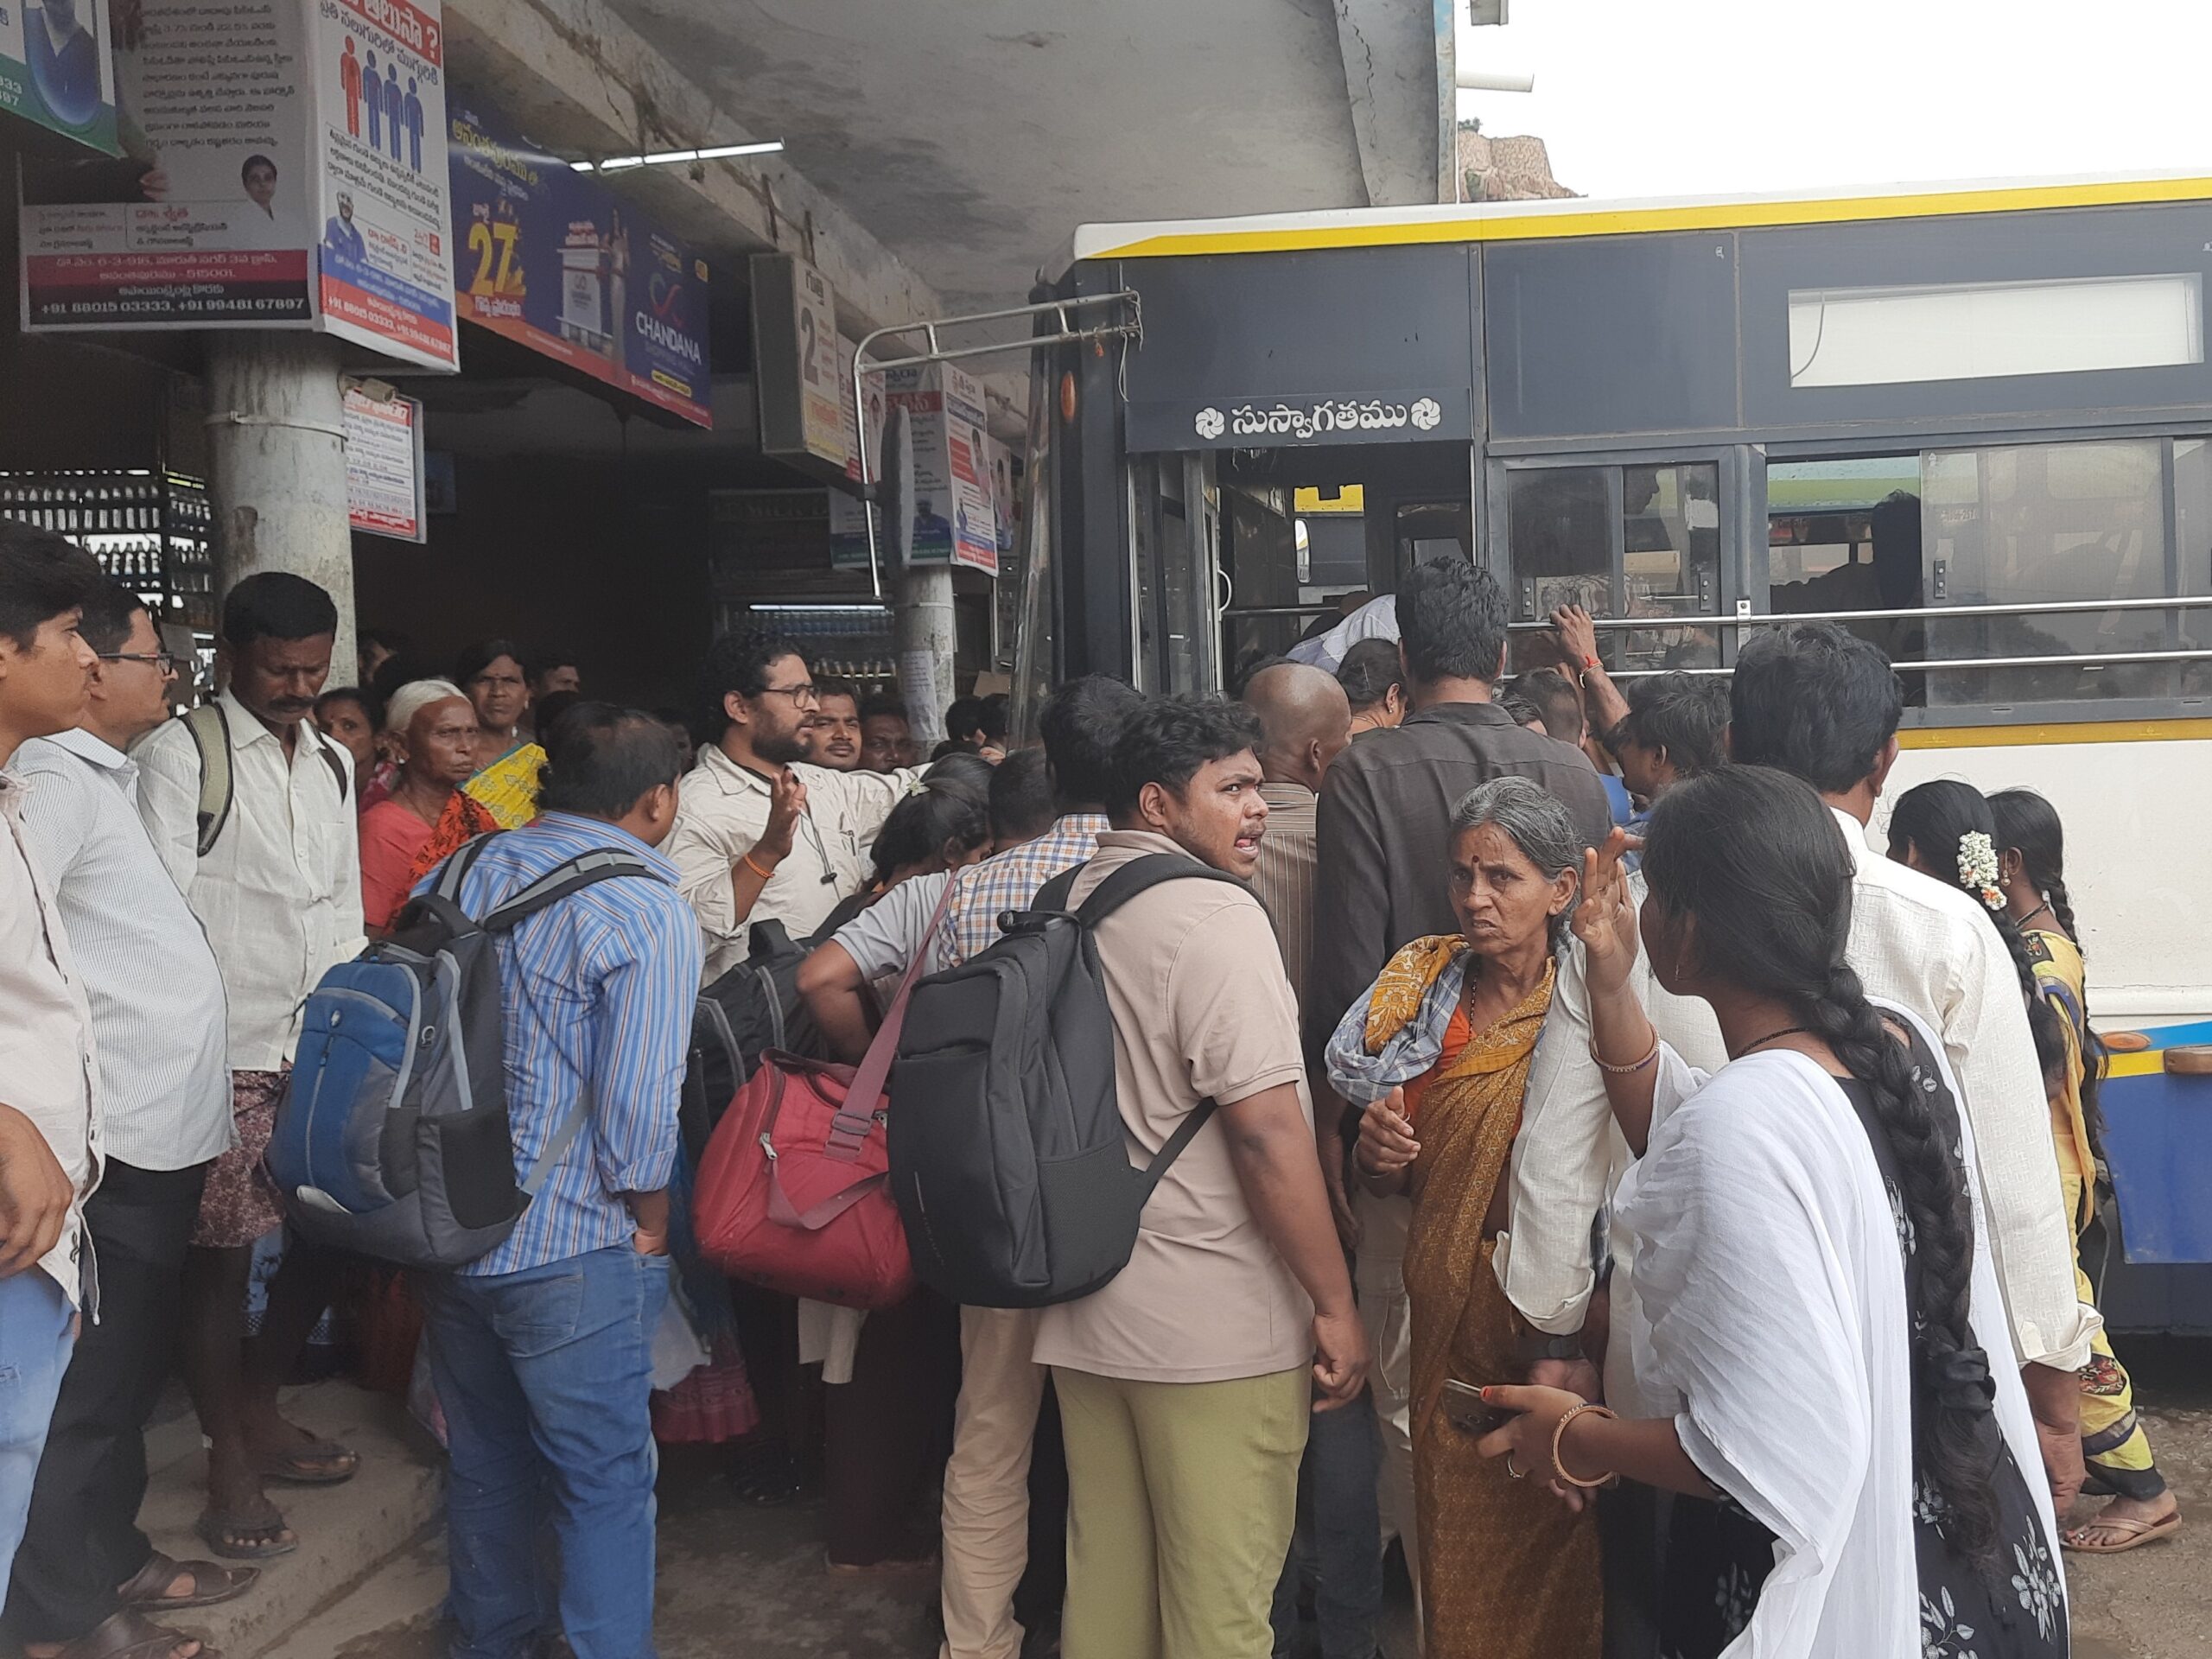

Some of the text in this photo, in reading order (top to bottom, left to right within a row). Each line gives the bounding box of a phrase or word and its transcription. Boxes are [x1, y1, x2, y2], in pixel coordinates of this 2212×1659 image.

[468, 221, 517, 296] 27
[41, 303, 67, 314] +91
[635, 311, 702, 365] CHANDANA
[801, 307, 820, 386] 2
[1231, 399, 1408, 439] సుస్వాగతము
